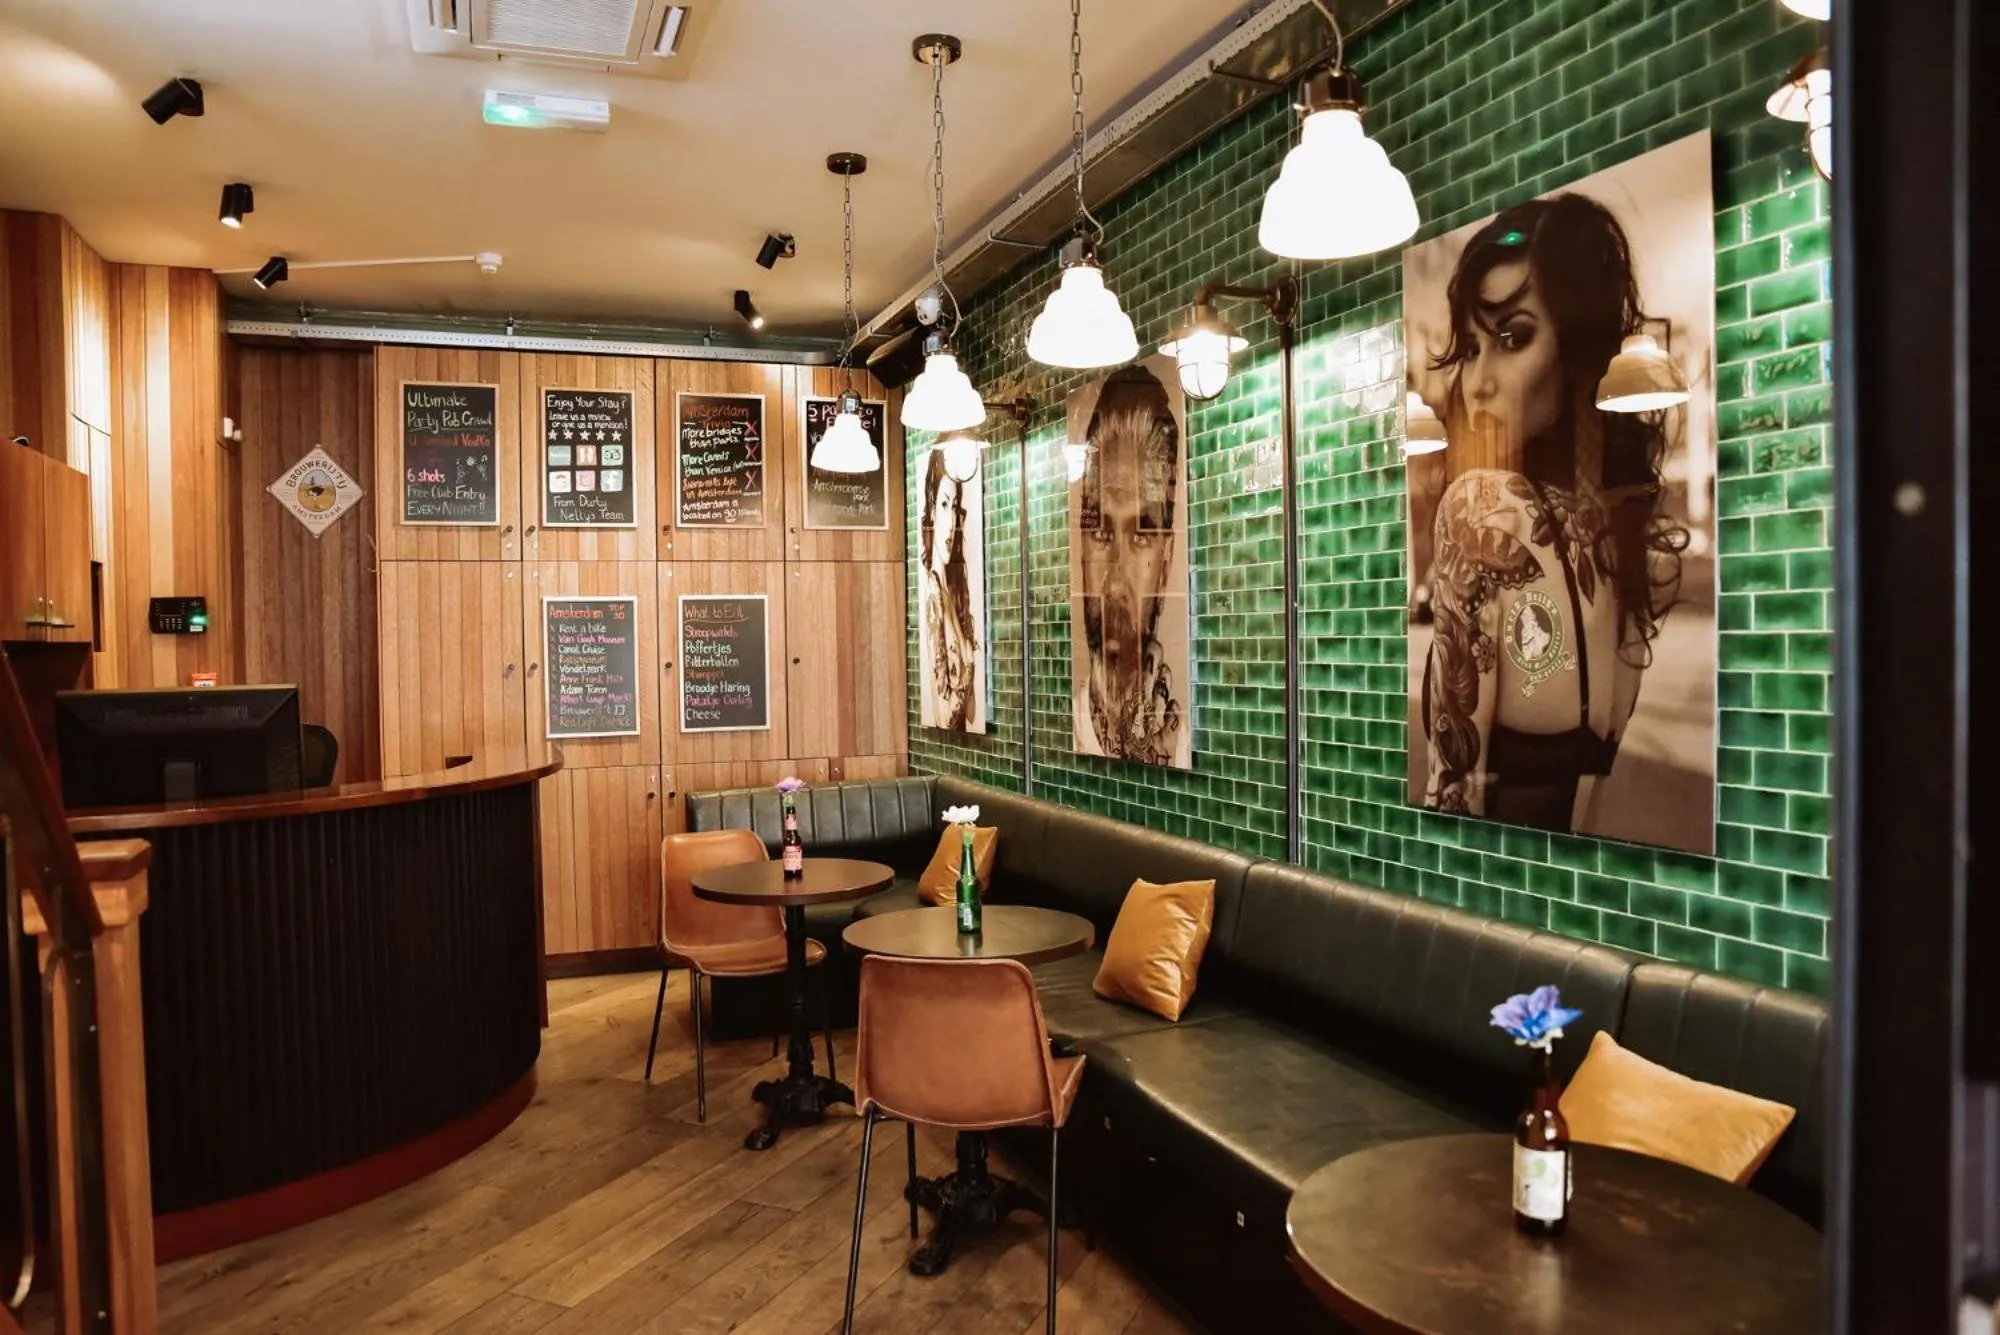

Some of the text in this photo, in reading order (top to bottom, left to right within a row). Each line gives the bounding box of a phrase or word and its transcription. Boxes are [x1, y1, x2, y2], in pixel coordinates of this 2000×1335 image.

[407, 391, 469, 408] Ultimate
[547, 394, 574, 412] Enjoy
[575, 395, 595, 408] Your
[807, 403, 818, 418] 5
[407, 411, 439, 434] Party
[442, 410, 460, 427] Pub
[706, 424, 742, 438] bridges
[407, 468, 446, 483] 6 shots
[407, 484, 429, 499] Free
[455, 484, 486, 501] Entry
[553, 495, 575, 508] From
[292, 504, 342, 520] AMSTERDAM
[598, 508, 624, 520] Team
[684, 604, 709, 619] What
[685, 639, 732, 657] Poffertjes
[719, 680, 751, 697] Haring
[686, 708, 721, 721] Cheese
